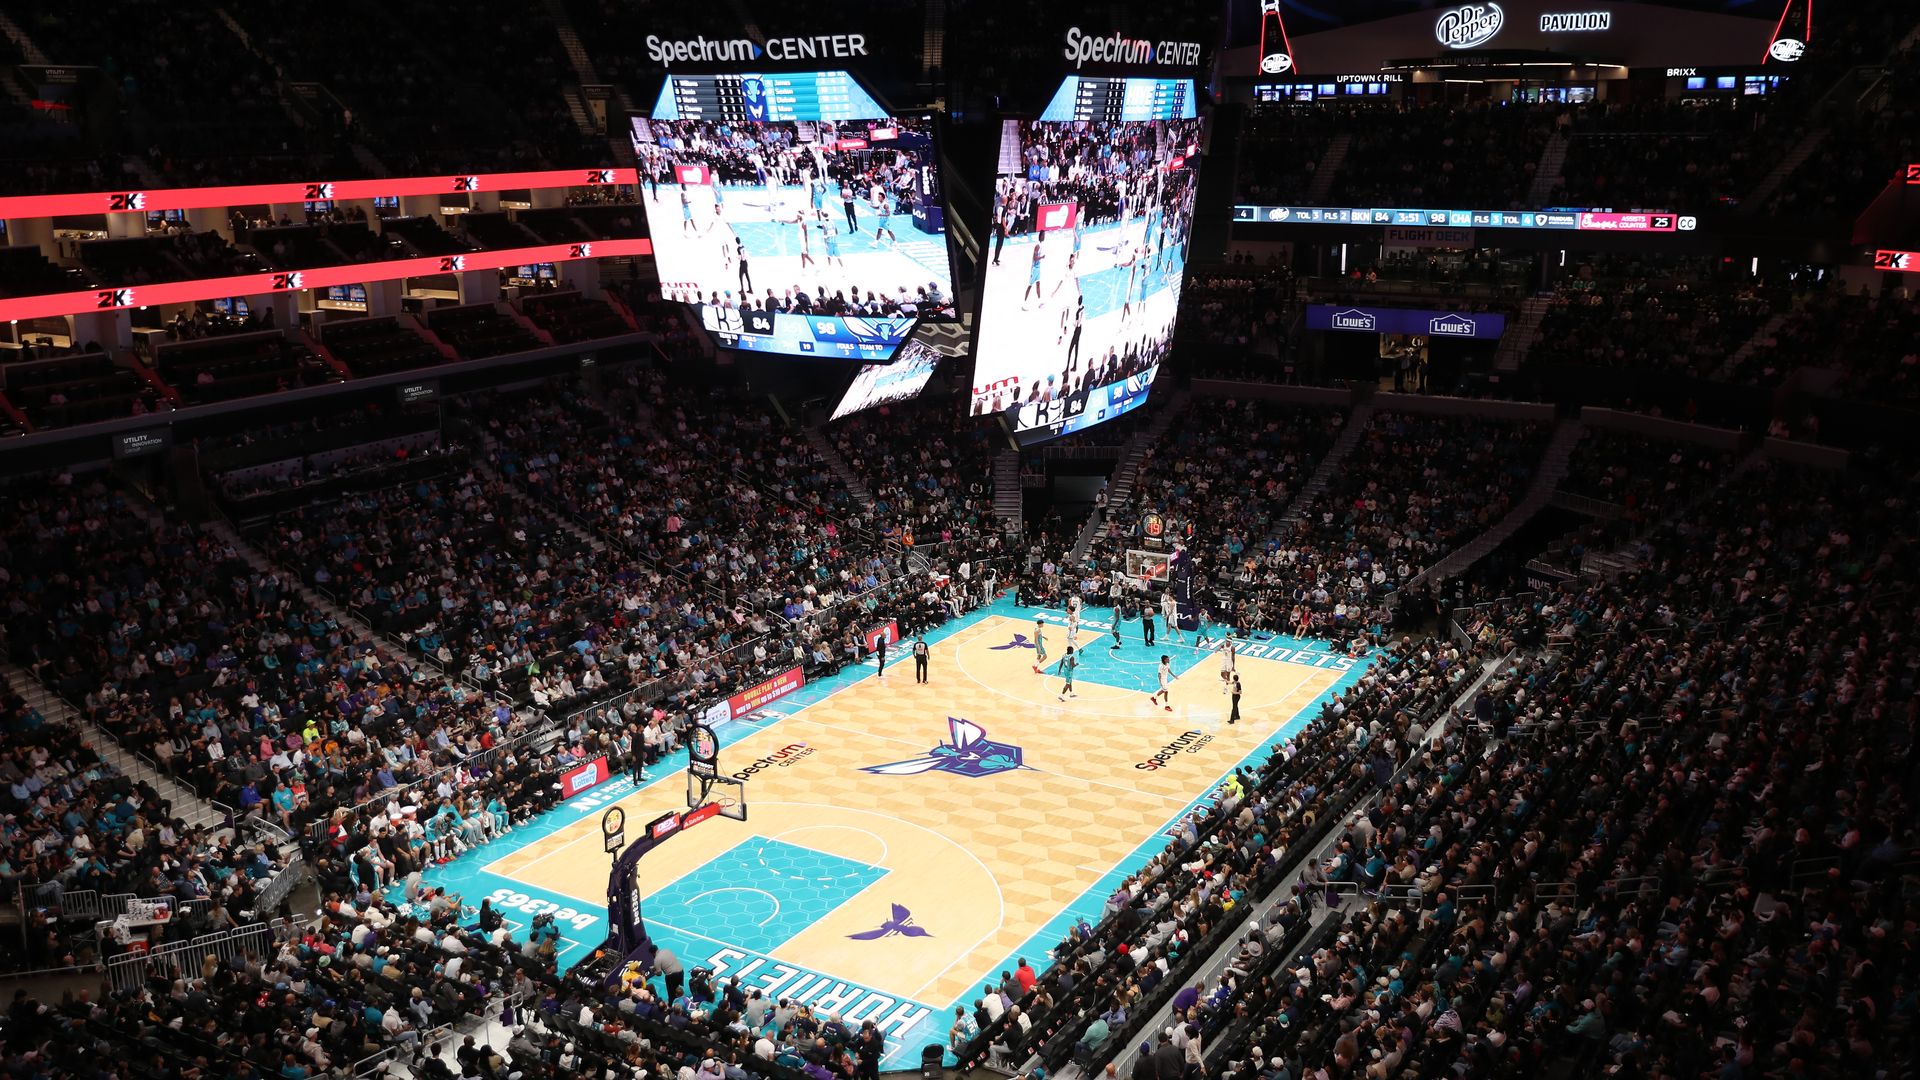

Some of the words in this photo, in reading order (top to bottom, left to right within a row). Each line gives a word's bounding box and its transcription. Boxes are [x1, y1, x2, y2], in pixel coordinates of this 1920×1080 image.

[1461, 7, 1483, 24] Dr
[1541, 12, 1610, 31] PAVILION
[1443, 13, 1498, 44] Pepper
[646, 34, 755, 68] Spectrum
[766, 34, 868, 61] CENTER
[1064, 27, 1151, 69] Spectrum
[1156, 41, 1200, 66] CENTER
[1667, 68, 1696, 77] BRIXX
[454, 177, 474, 191] 2K
[587, 170, 611, 184] 2K
[305, 184, 330, 199] 2K
[110, 194, 141, 210] 2K
[1240, 210, 1247, 218] 4
[1296, 212, 1311, 220] TOL
[1313, 211, 1319, 219] 3
[1324, 212, 1338, 220] FLS
[1340, 212, 1347, 220] 2
[1351, 212, 1370, 222] BKN
[1375, 213, 1388, 222] 84
[1398, 213, 1419, 222] 3:51
[1431, 214, 1446, 223] 98
[1451, 214, 1470, 223] CHA
[1474, 215, 1489, 224] FLS
[1503, 216, 1519, 224] TOL
[1654, 217, 1668, 227] 25
[1680, 219, 1694, 228] CC
[1390, 230, 1433, 241] FLIGHT
[1436, 231, 1470, 242] DECK
[570, 244, 588, 257] 2K
[440, 257, 461, 271] 2K
[1875, 252, 1909, 268] 2K
[273, 274, 299, 289] 2K
[98, 289, 129, 308] 2K
[752, 317, 770, 332] 84
[816, 322, 837, 336] 98
[1337, 316, 1372, 328] LOWE'S
[1434, 321, 1471, 334] LOWE'S
[803, 342, 811, 351] 19
[123, 434, 148, 444] UTILITY
[131, 438, 162, 448] INNOVATION
[1199, 637, 1359, 671] HORNETS
[744, 686, 761, 701] DOUBLE
[762, 682, 773, 694] PLAY
[778, 676, 788, 686] NEW
[736, 704, 746, 715] way
[745, 701, 752, 710] to
[761, 695, 767, 704] up
[772, 688, 781, 699] $10
[780, 681, 798, 696] MILLION
[1135, 731, 1201, 771] Spectrum
[1186, 734, 1212, 753] CENTER
[732, 743, 805, 781] pectrum
[778, 747, 815, 767] CENTER
[657, 816, 675, 831] DEX
[486, 889, 600, 930] bet365
[631, 888, 640, 926] bet365
[690, 947, 932, 1040] HORNETS
